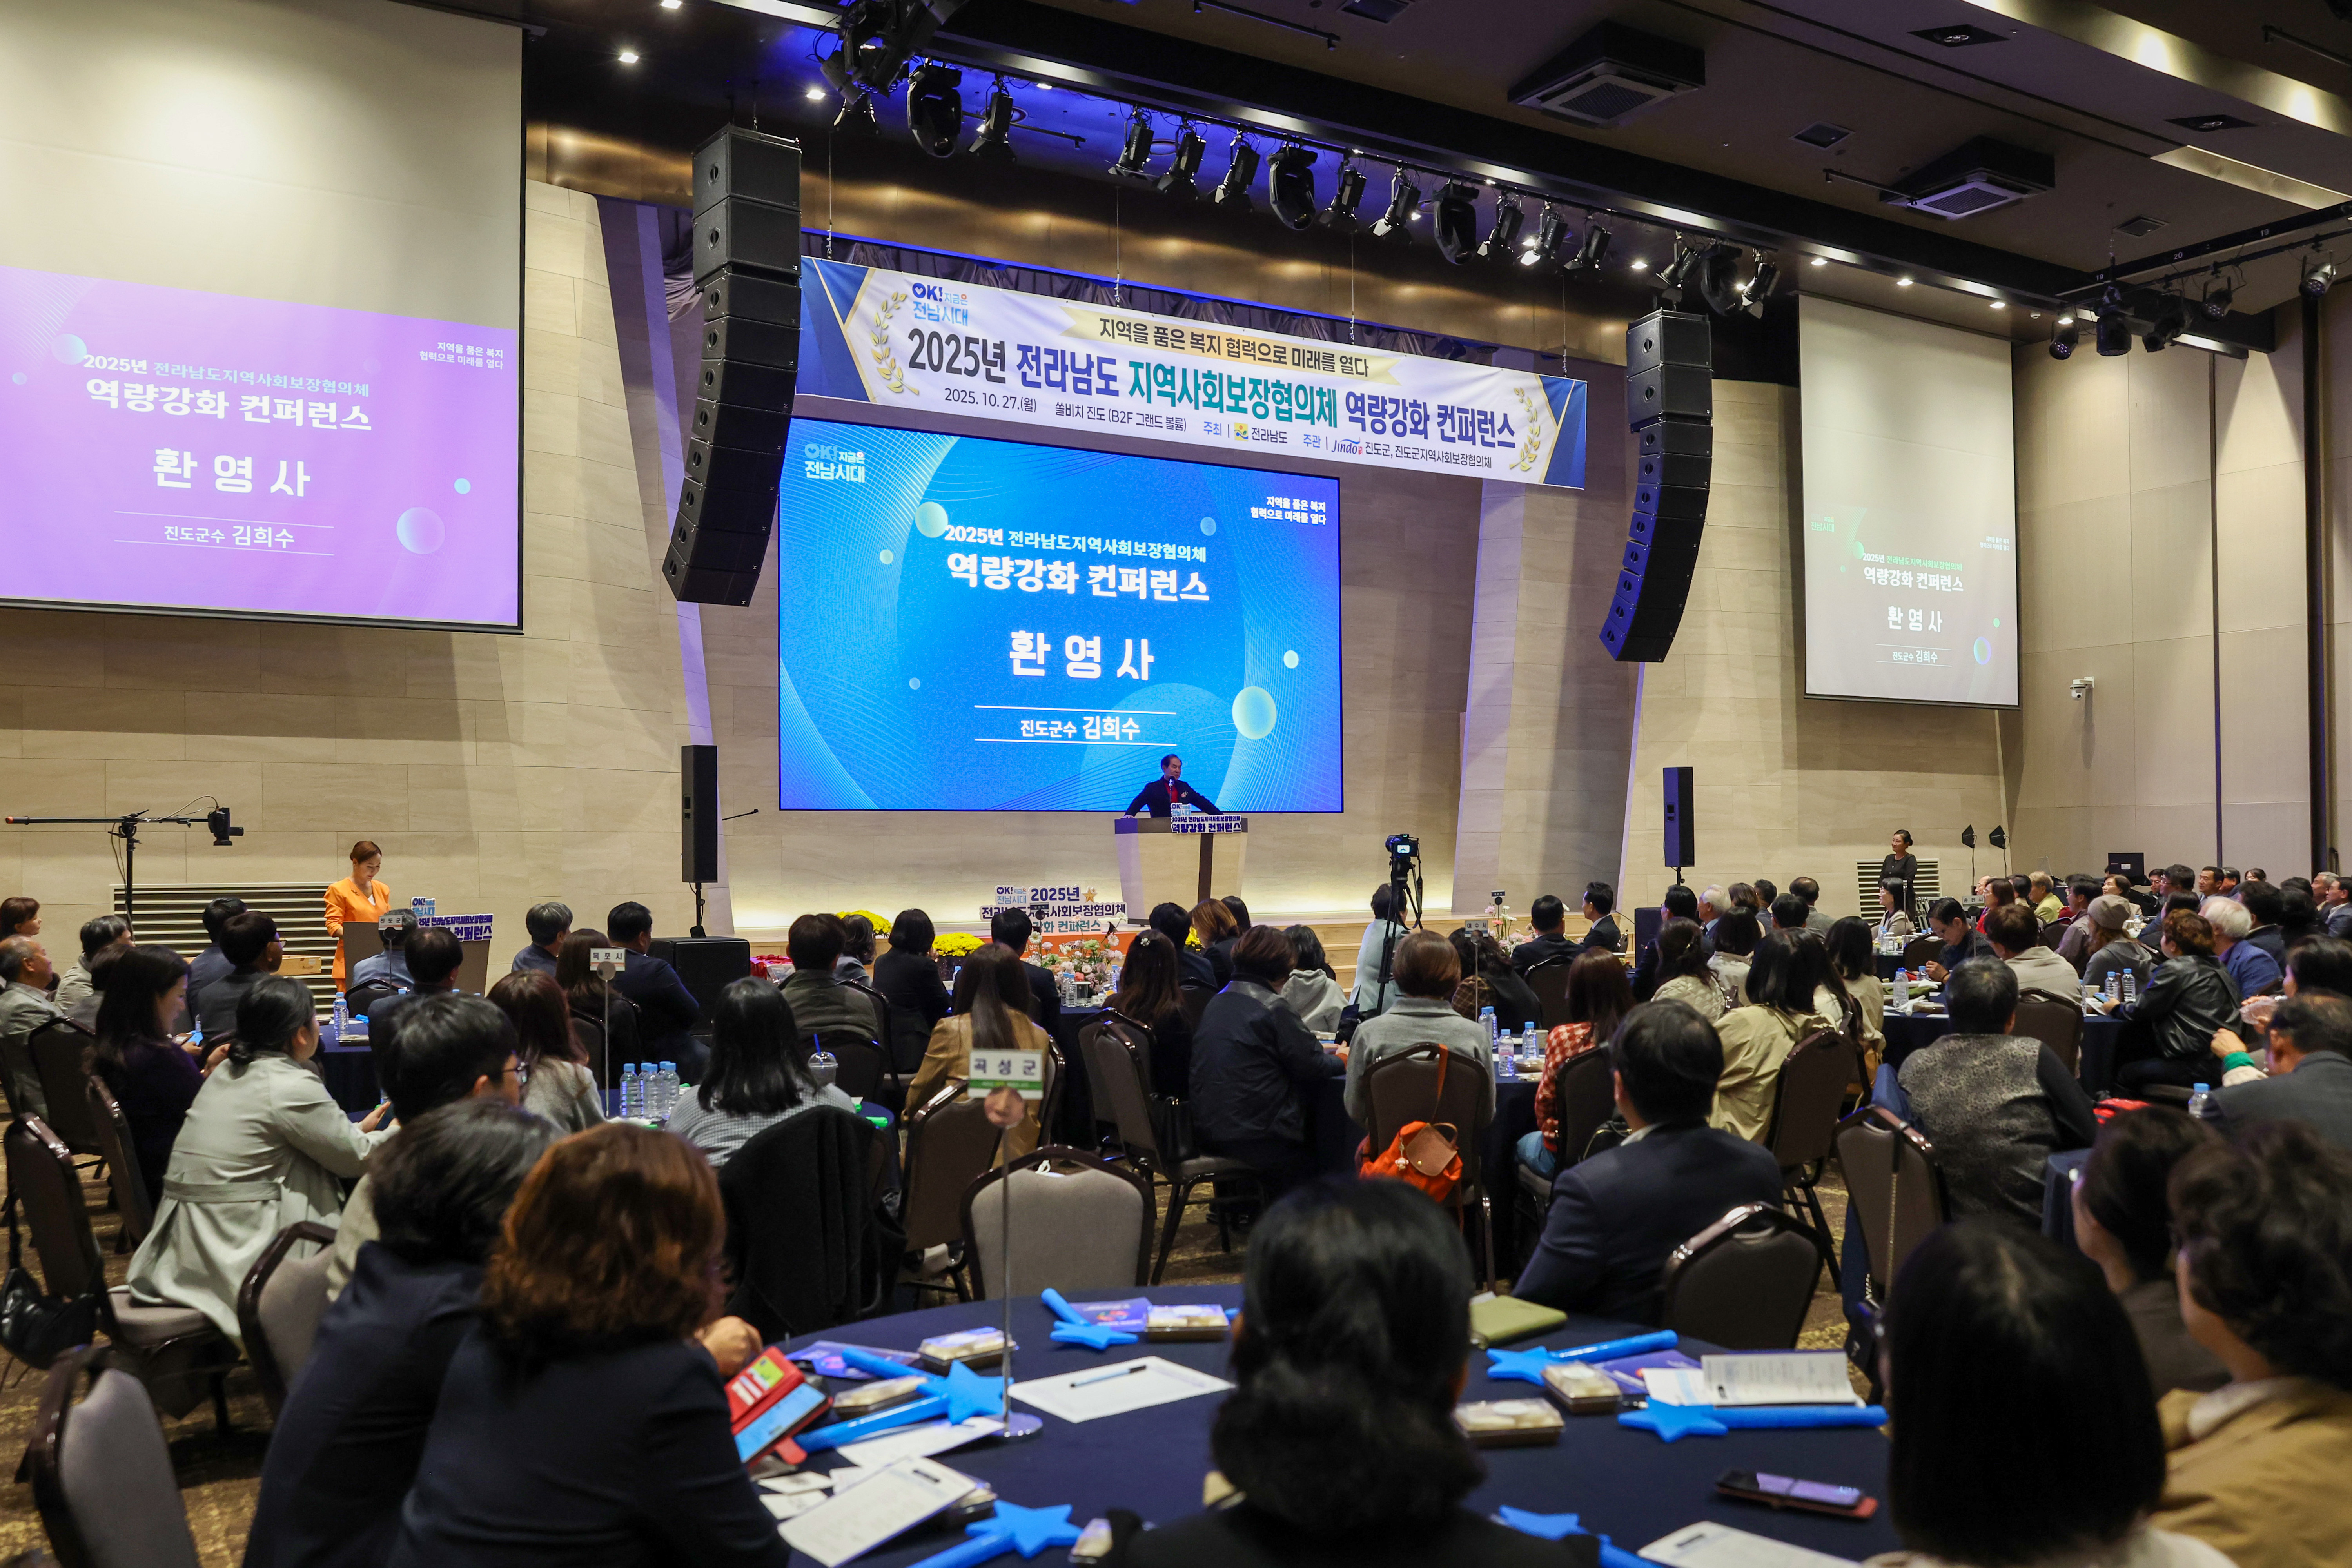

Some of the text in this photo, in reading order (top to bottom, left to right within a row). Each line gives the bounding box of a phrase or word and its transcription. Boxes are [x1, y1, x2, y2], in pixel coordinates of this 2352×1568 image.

[912, 283, 968, 305] OK! 지금은
[913, 301, 968, 326] 전남시대
[437, 342, 503, 359] 지역을 품은 복지
[1100, 318, 1369, 377] 지역을 품은 복지 협력으로 미래를 열다
[419, 350, 504, 370] 협력으로 미래를 열다
[83, 354, 370, 397] 2025년 전라남도지역사회보장협의체
[908, 328, 1516, 448] 2025년 전라남도 지역사회보장협의체 역량강화 컨퍼런스
[86, 379, 372, 430] 역량강화 컨퍼런스
[944, 388, 978, 405] 2025.
[1055, 402, 1084, 419] 쏠비치
[1087, 406, 1105, 421] 진도
[1108, 408, 1133, 425] (B2F
[1136, 412, 1163, 428] 그랜드
[1165, 416, 1187, 432] 볼륨)
[1203, 421, 1222, 436] 주최
[1252, 427, 1288, 444] 전라남도
[1303, 434, 1321, 448] 주관
[1365, 441, 1393, 458] 진도군,
[1395, 445, 1492, 469] 진도군지역사회보장협의체
[838, 452, 865, 464] 지금은
[805, 461, 865, 483] 전남시대
[1250, 506, 1327, 525] 협력으로 미래를 열다
[1267, 496, 1326, 513] 지역을 품은 복지
[164, 526, 295, 548] 진도군수 김희수
[1811, 521, 1835, 532] 전남시대
[944, 524, 1207, 562] 2025년 전라남도지역사회보장협의체
[1863, 552, 1962, 571] 2025년 전라남도지역사회보장협의체
[947, 553, 1210, 601] 역량강화 컨퍼런스
[1864, 566, 1964, 591] 역량강화 컨퍼런스
[1892, 650, 1938, 663] 진도군수 김희수
[1020, 716, 1140, 741] 진도군수 김희수
[1172, 823, 1241, 833] 역량강화 컨퍼런스
[997, 895, 1026, 904] 전남시대
[1031, 886, 1080, 901] 2025년
[1058, 920, 1101, 933] 컨퍼런스
